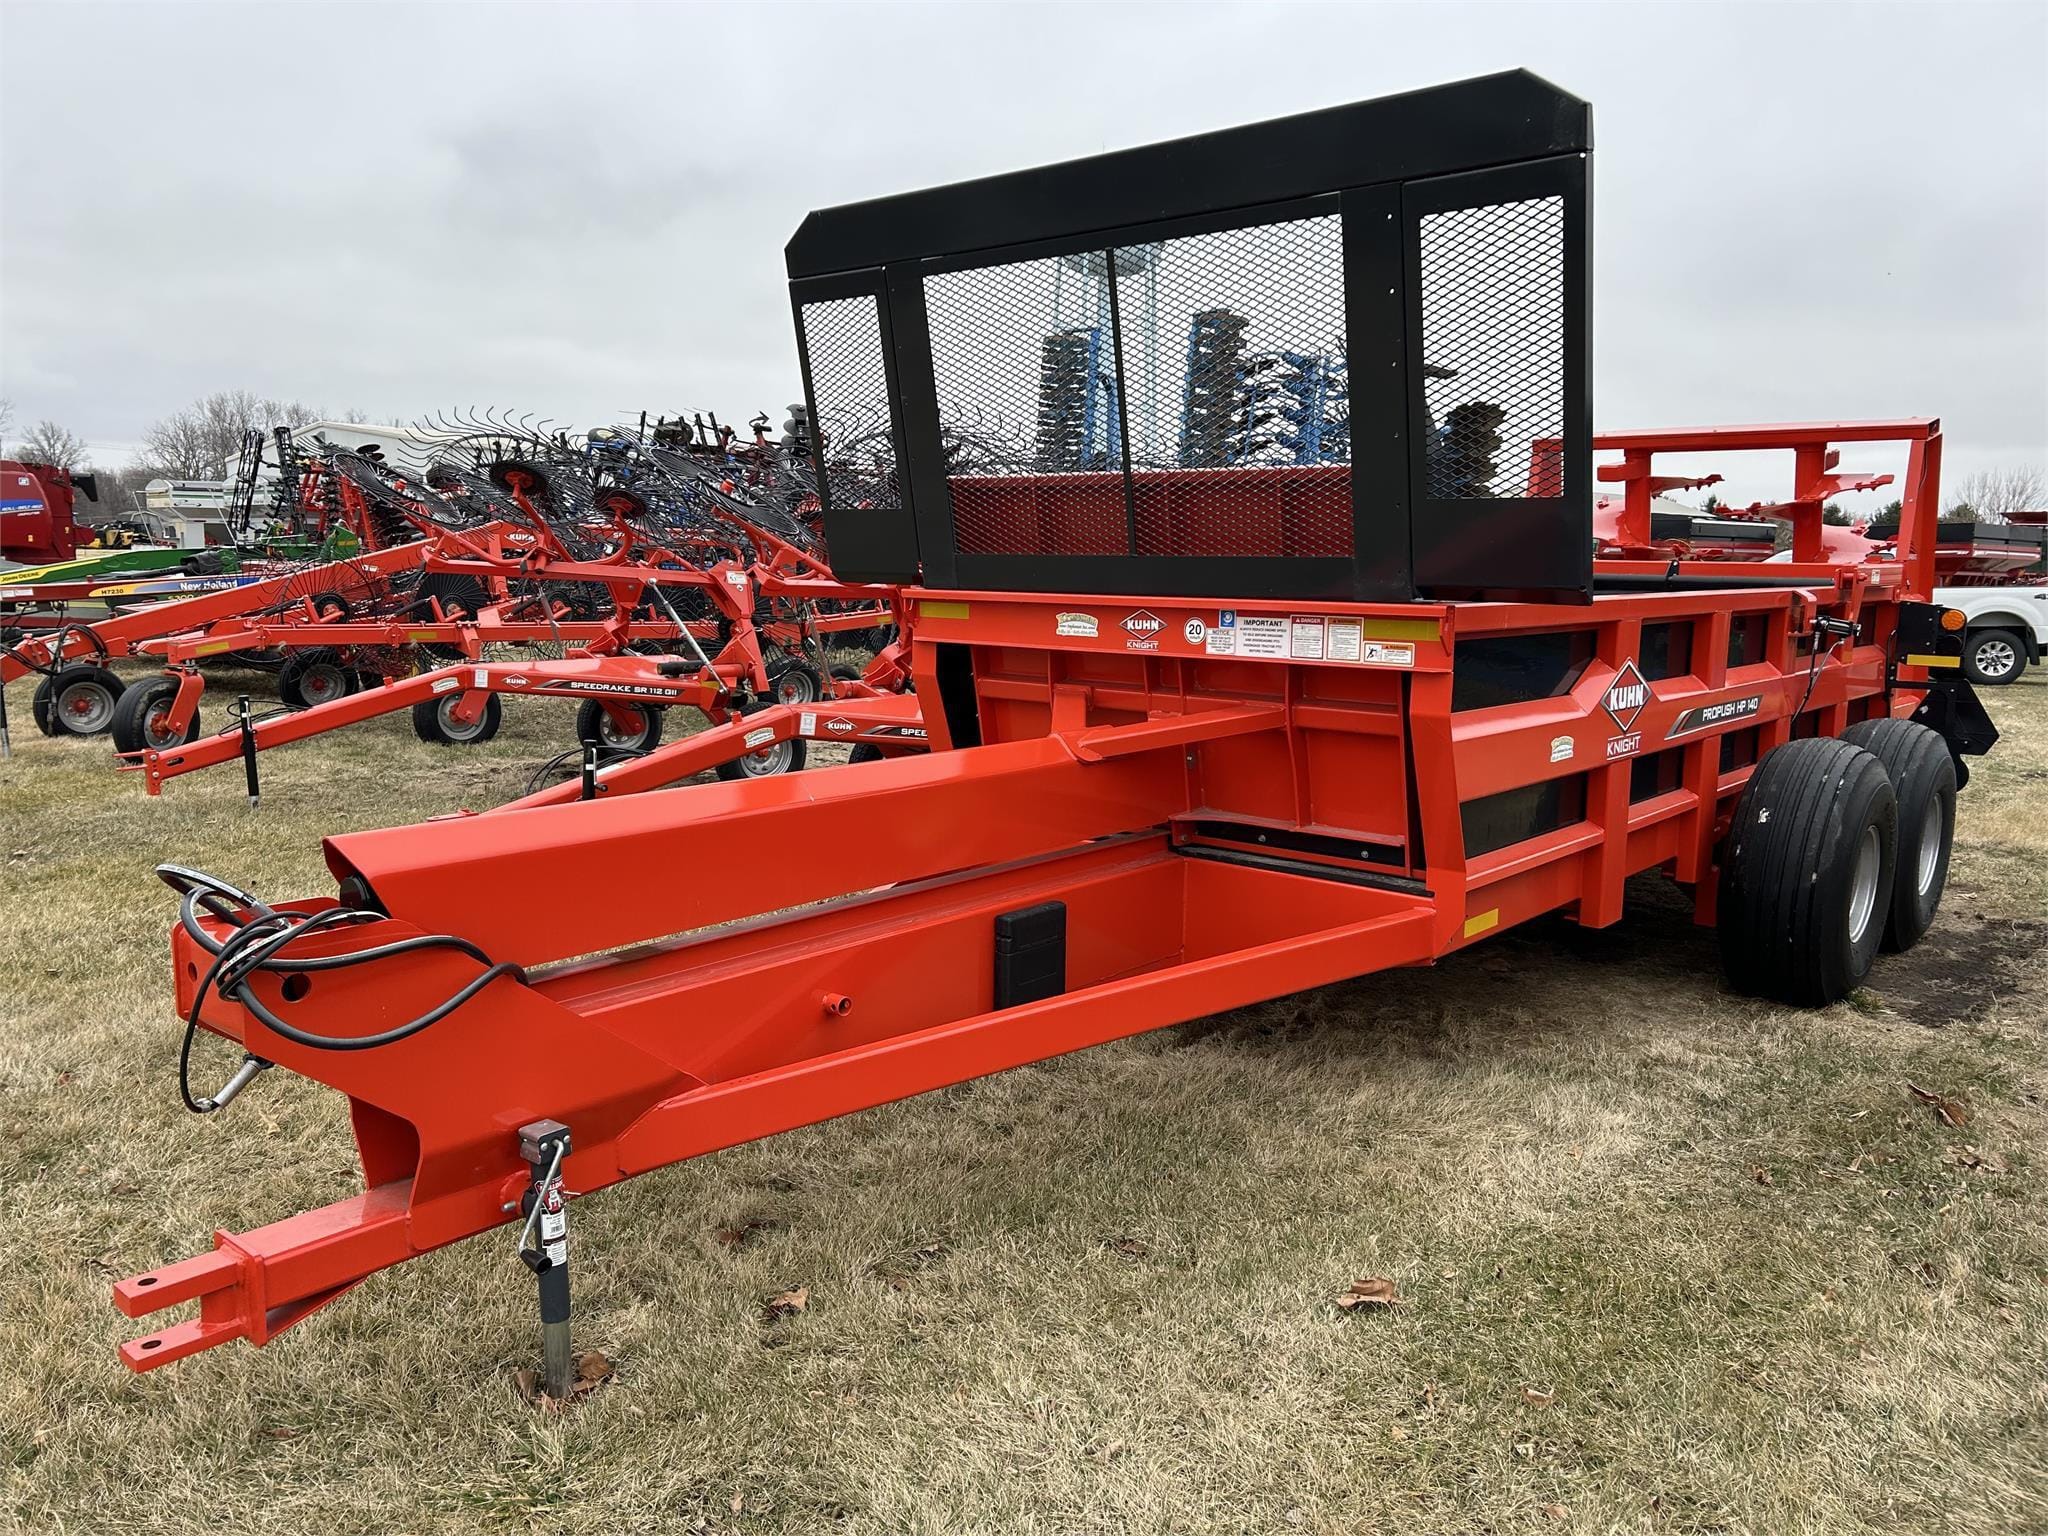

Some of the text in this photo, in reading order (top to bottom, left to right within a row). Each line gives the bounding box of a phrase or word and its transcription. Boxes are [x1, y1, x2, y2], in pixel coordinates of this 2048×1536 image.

[180, 580, 238, 591] New Holland
[1127, 619, 1159, 631] KUHN
[1243, 619, 1284, 627] IMPORTANT
[1188, 623, 1202, 636] 20
[1126, 641, 1159, 649] KNIGHT
[570, 681, 631, 692] SPEEDRAKE
[634, 686, 648, 694] SR
[649, 687, 663, 695] 112
[1610, 684, 1644, 711] KUHN
[1702, 697, 1759, 722] PROPUSH HP 140
[828, 722, 852, 730] KUHN
[1606, 736, 1641, 757] KNIGHT
